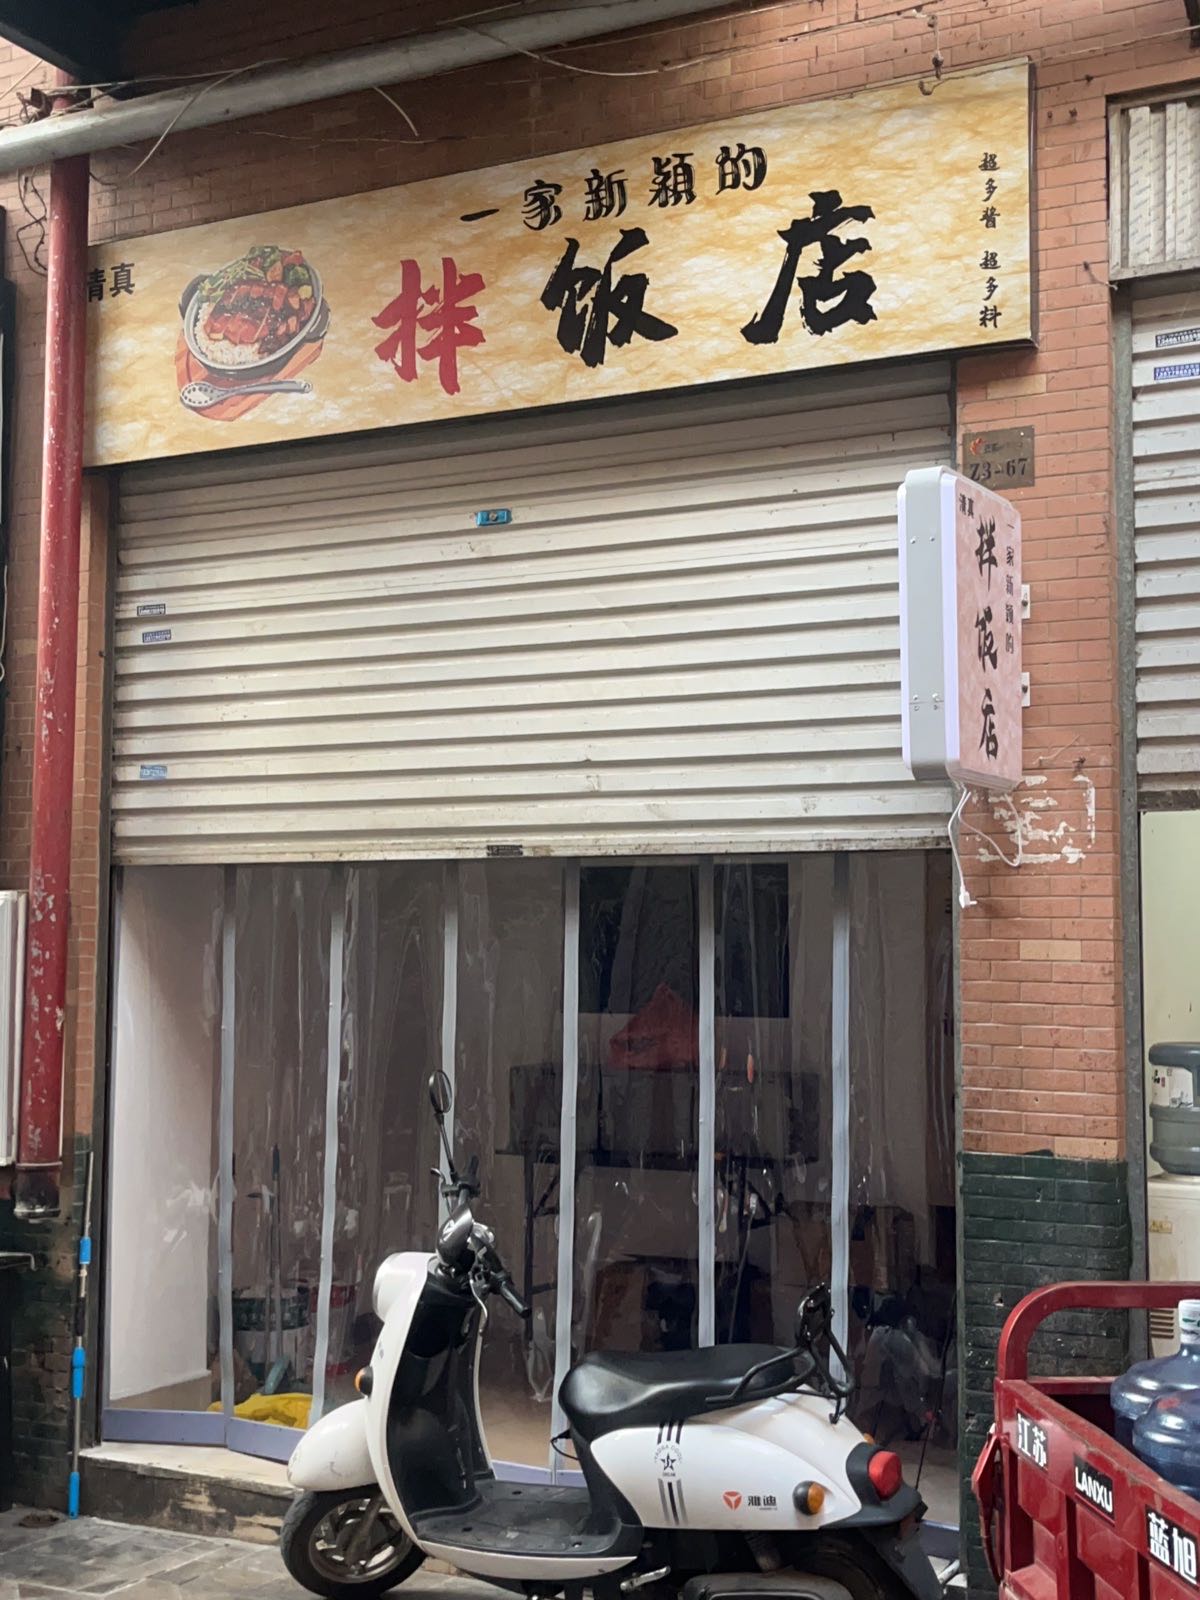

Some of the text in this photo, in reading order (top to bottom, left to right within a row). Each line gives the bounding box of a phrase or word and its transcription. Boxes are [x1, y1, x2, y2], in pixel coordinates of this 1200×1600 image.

[978, 152, 1002, 328] 超多酱 超多料
[372, 189, 878, 395] 拌饭店
[970, 457, 1028, 481] Z3-67
[974, 513, 998, 761] 拌饭店
[1017, 1411, 1047, 1468] 江苏
[747, 1495, 777, 1507] 雅迪
[1075, 1466, 1113, 1513] LANXU
[1147, 1512, 1198, 1585] 蓝旭
